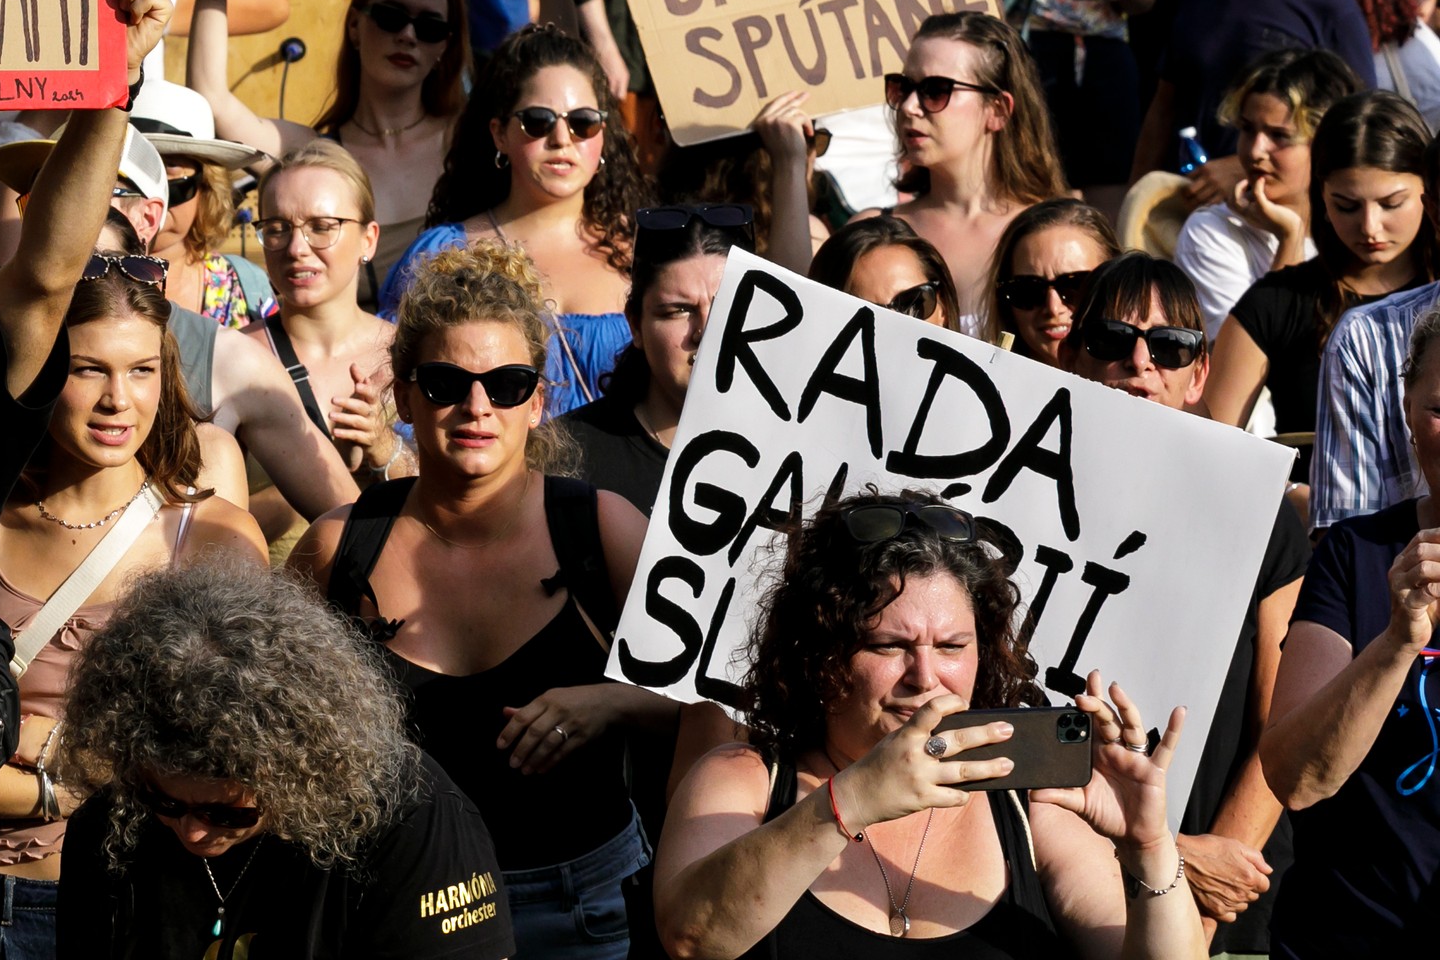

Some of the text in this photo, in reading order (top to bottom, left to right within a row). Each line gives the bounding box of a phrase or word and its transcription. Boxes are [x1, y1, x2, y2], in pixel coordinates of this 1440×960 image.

[715, 269, 1080, 542] RADA
[421, 871, 497, 918] HARMÓNIA
[441, 902, 496, 934] orchester
